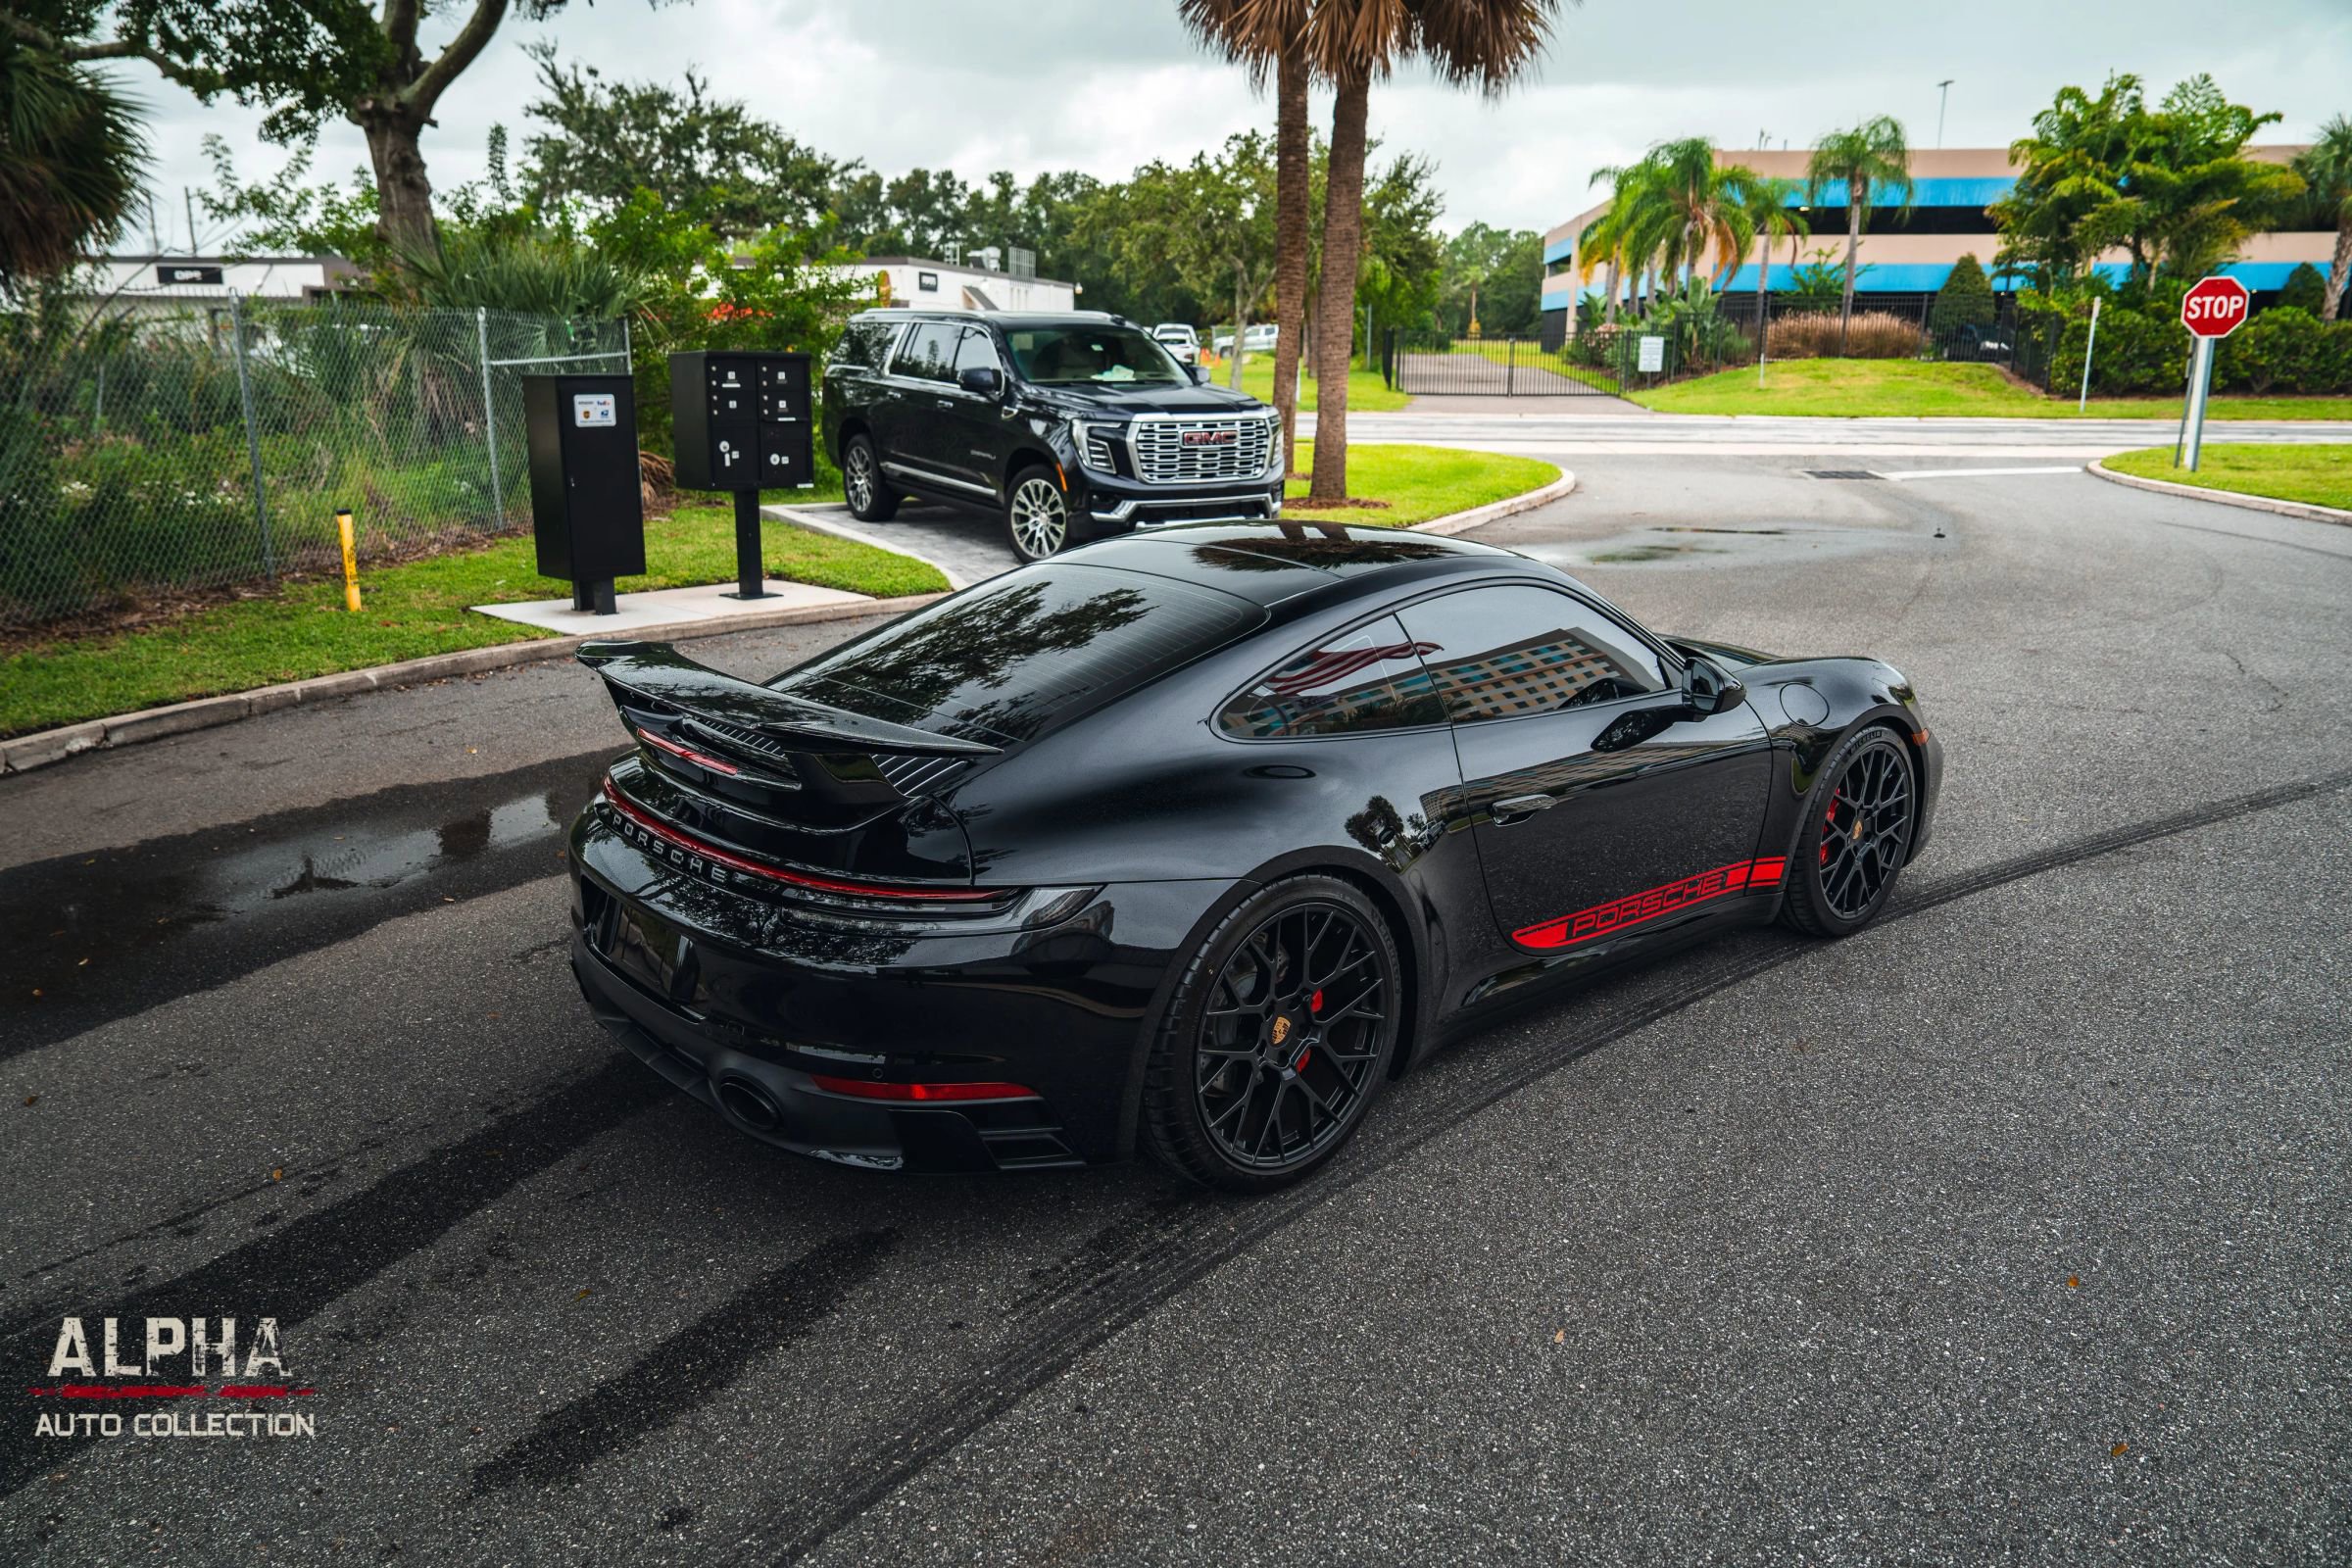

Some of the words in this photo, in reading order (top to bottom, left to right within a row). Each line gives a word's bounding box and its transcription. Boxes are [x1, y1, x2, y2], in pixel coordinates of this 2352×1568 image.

[2186, 295, 2244, 319] STOP
[1184, 431, 1238, 445] GMC
[612, 813, 726, 883] PORSCHE
[1572, 873, 1725, 937] PORSCHE
